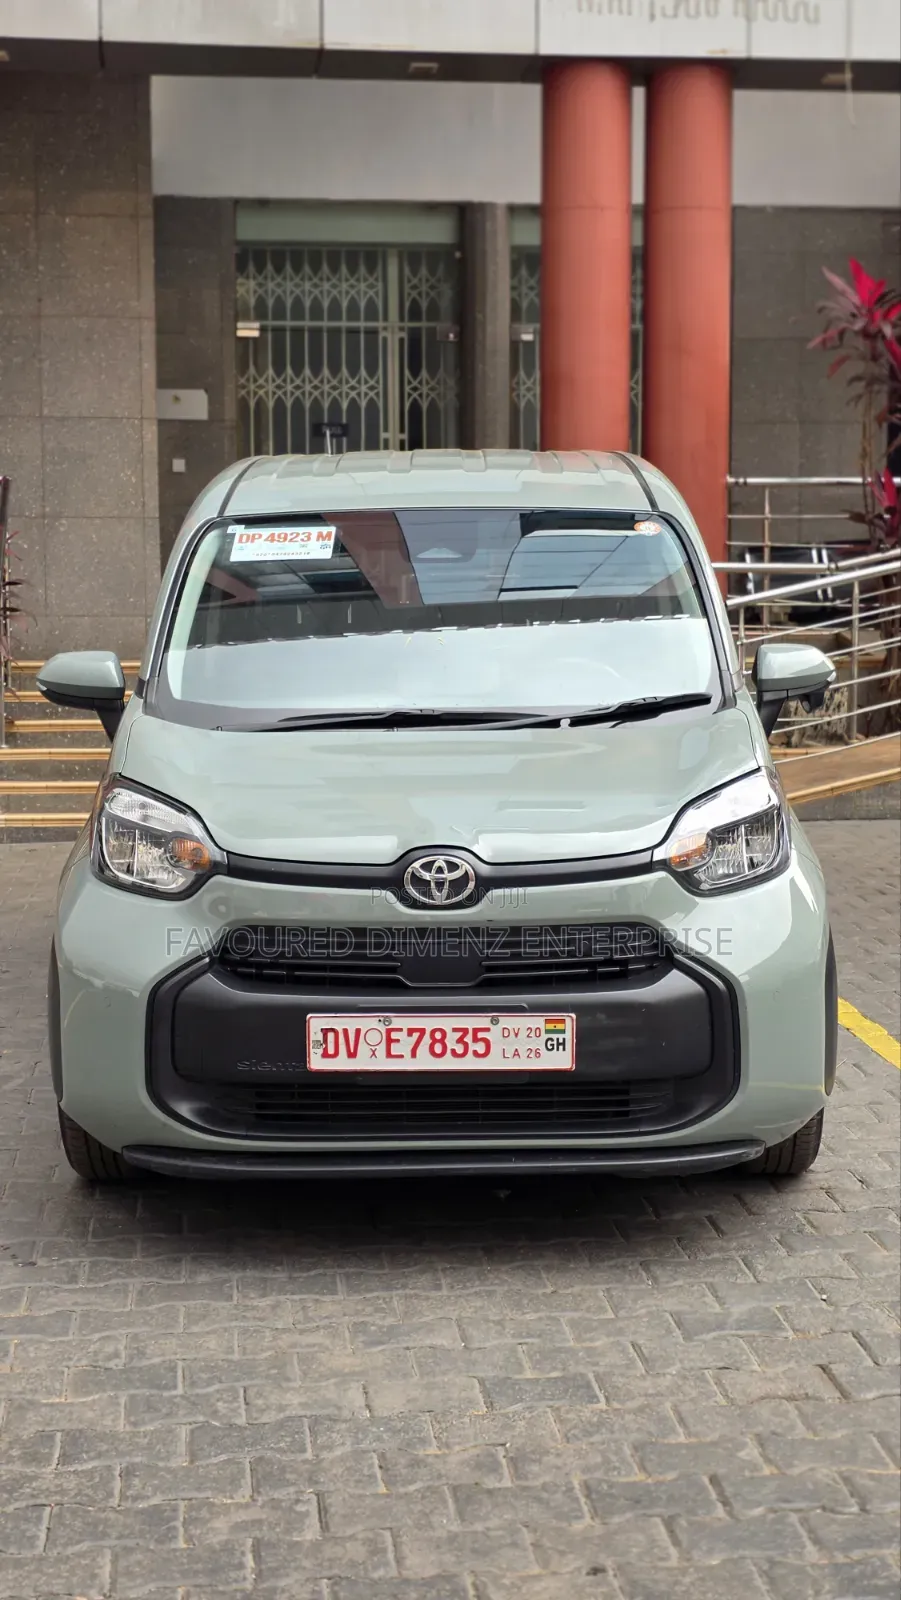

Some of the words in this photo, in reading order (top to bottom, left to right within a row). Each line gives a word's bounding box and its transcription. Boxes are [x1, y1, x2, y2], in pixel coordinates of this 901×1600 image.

[238, 533, 262, 544] DP
[264, 531, 312, 543] 4923
[316, 531, 333, 542] M
[502, 1027, 521, 1039] DV
[526, 1027, 542, 1038] 20
[320, 1027, 362, 1059] DV
[385, 1027, 492, 1059] E7835
[544, 1037, 566, 1052] GH
[502, 1048, 521, 1059] LA
[526, 1048, 542, 1059] 26
